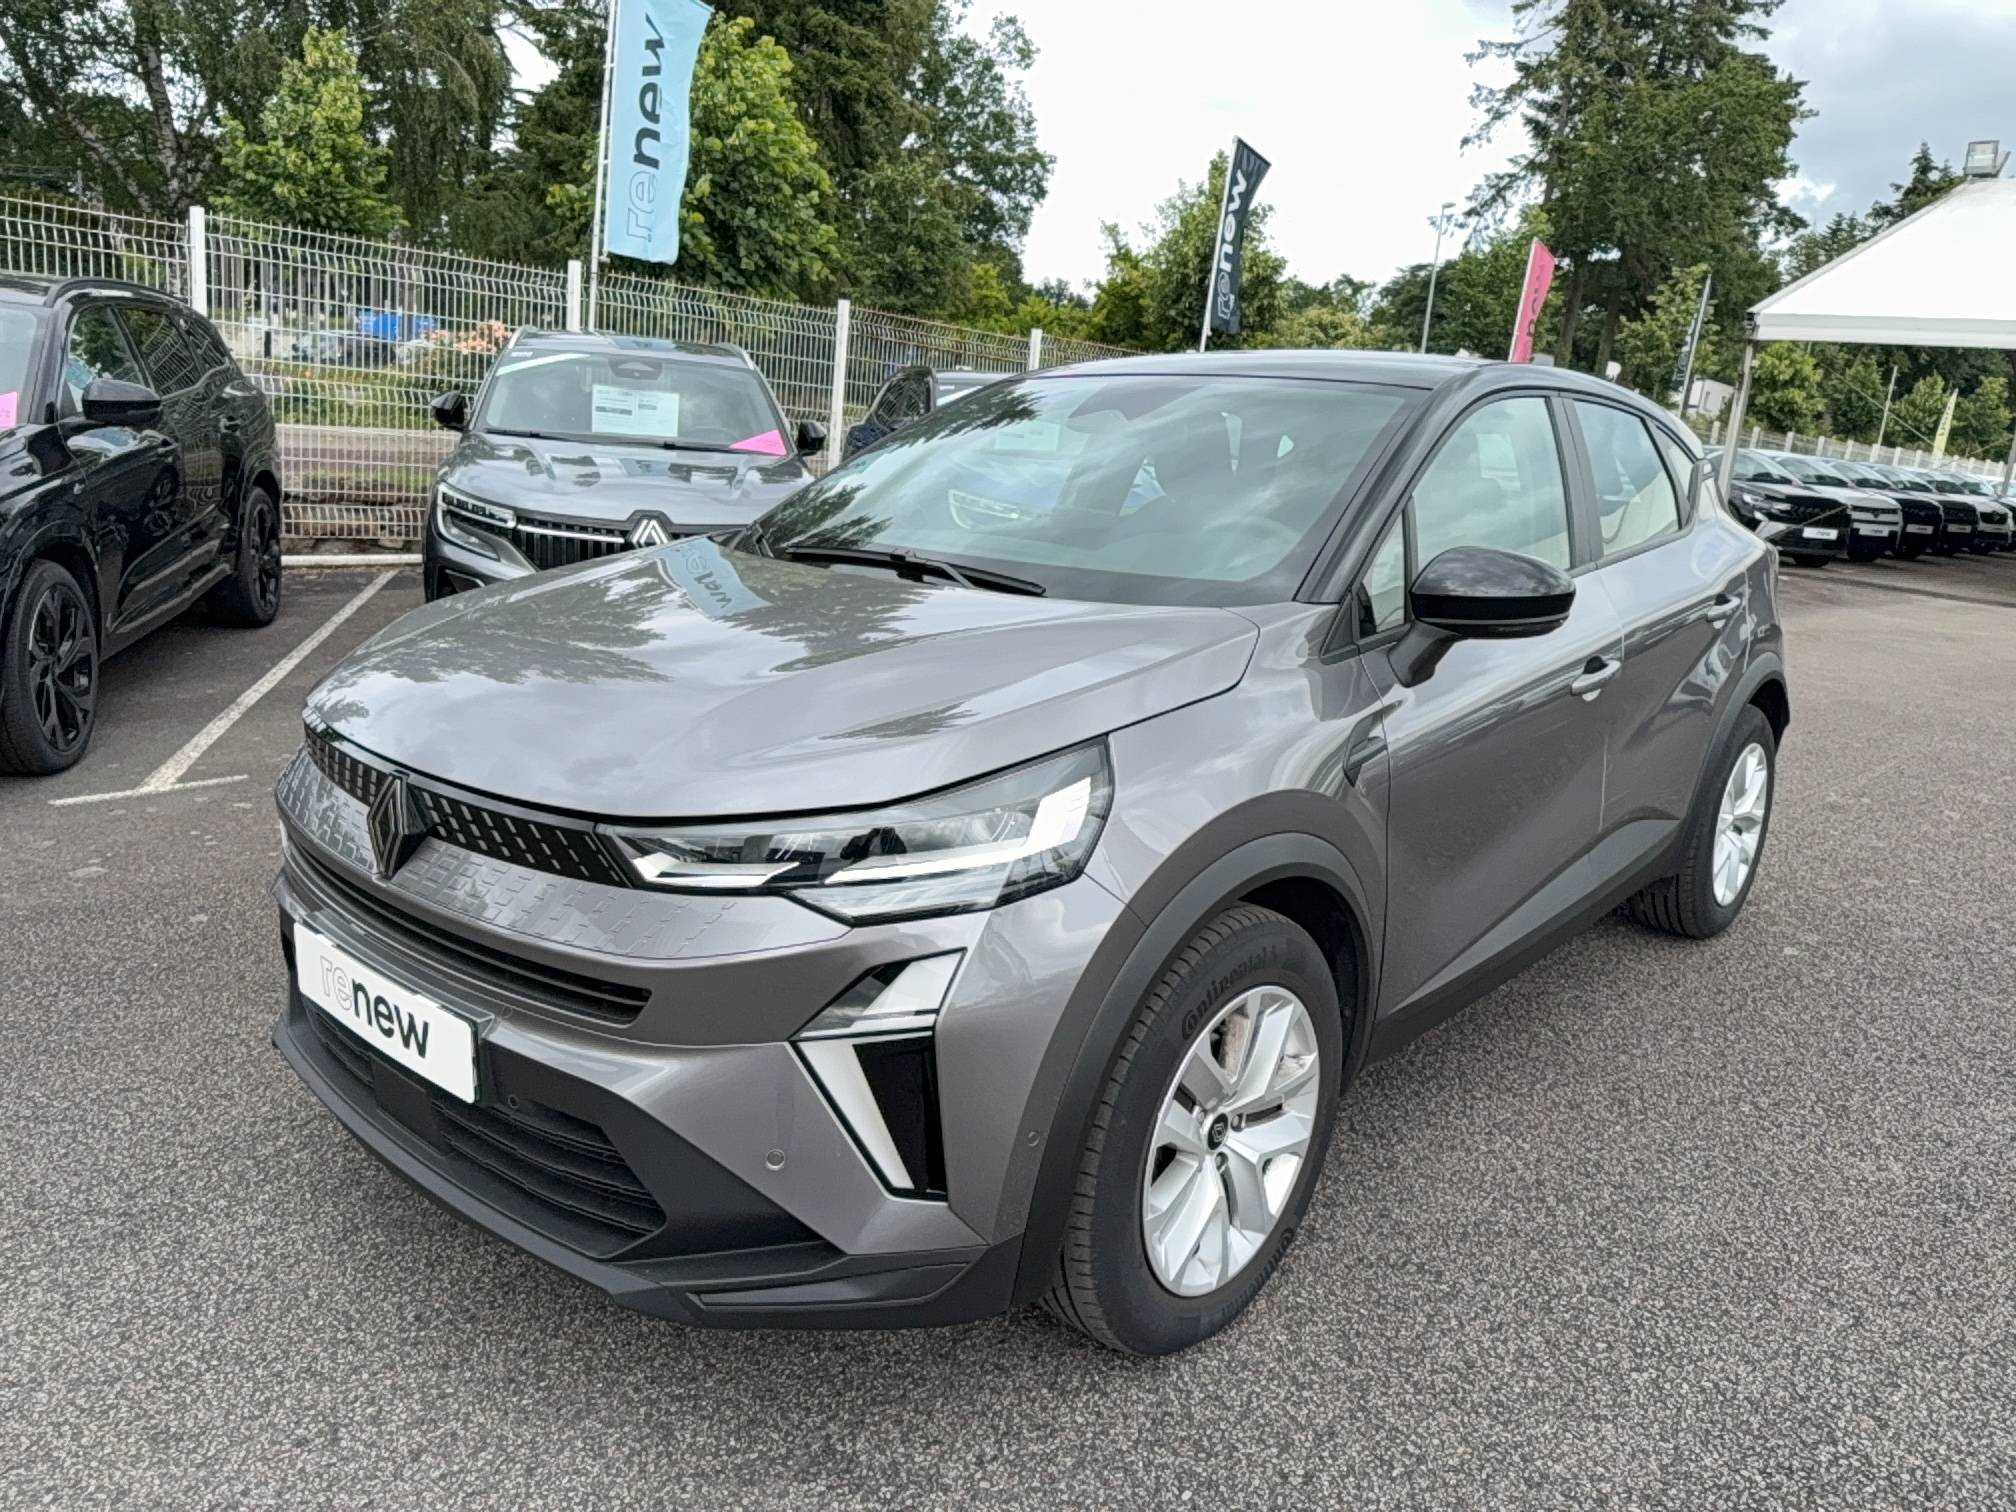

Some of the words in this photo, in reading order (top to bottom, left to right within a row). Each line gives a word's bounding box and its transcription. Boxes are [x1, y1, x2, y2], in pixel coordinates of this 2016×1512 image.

[626, 13, 666, 243] renew
[1217, 169, 1248, 320] renew
[319, 955, 430, 1059] renew
